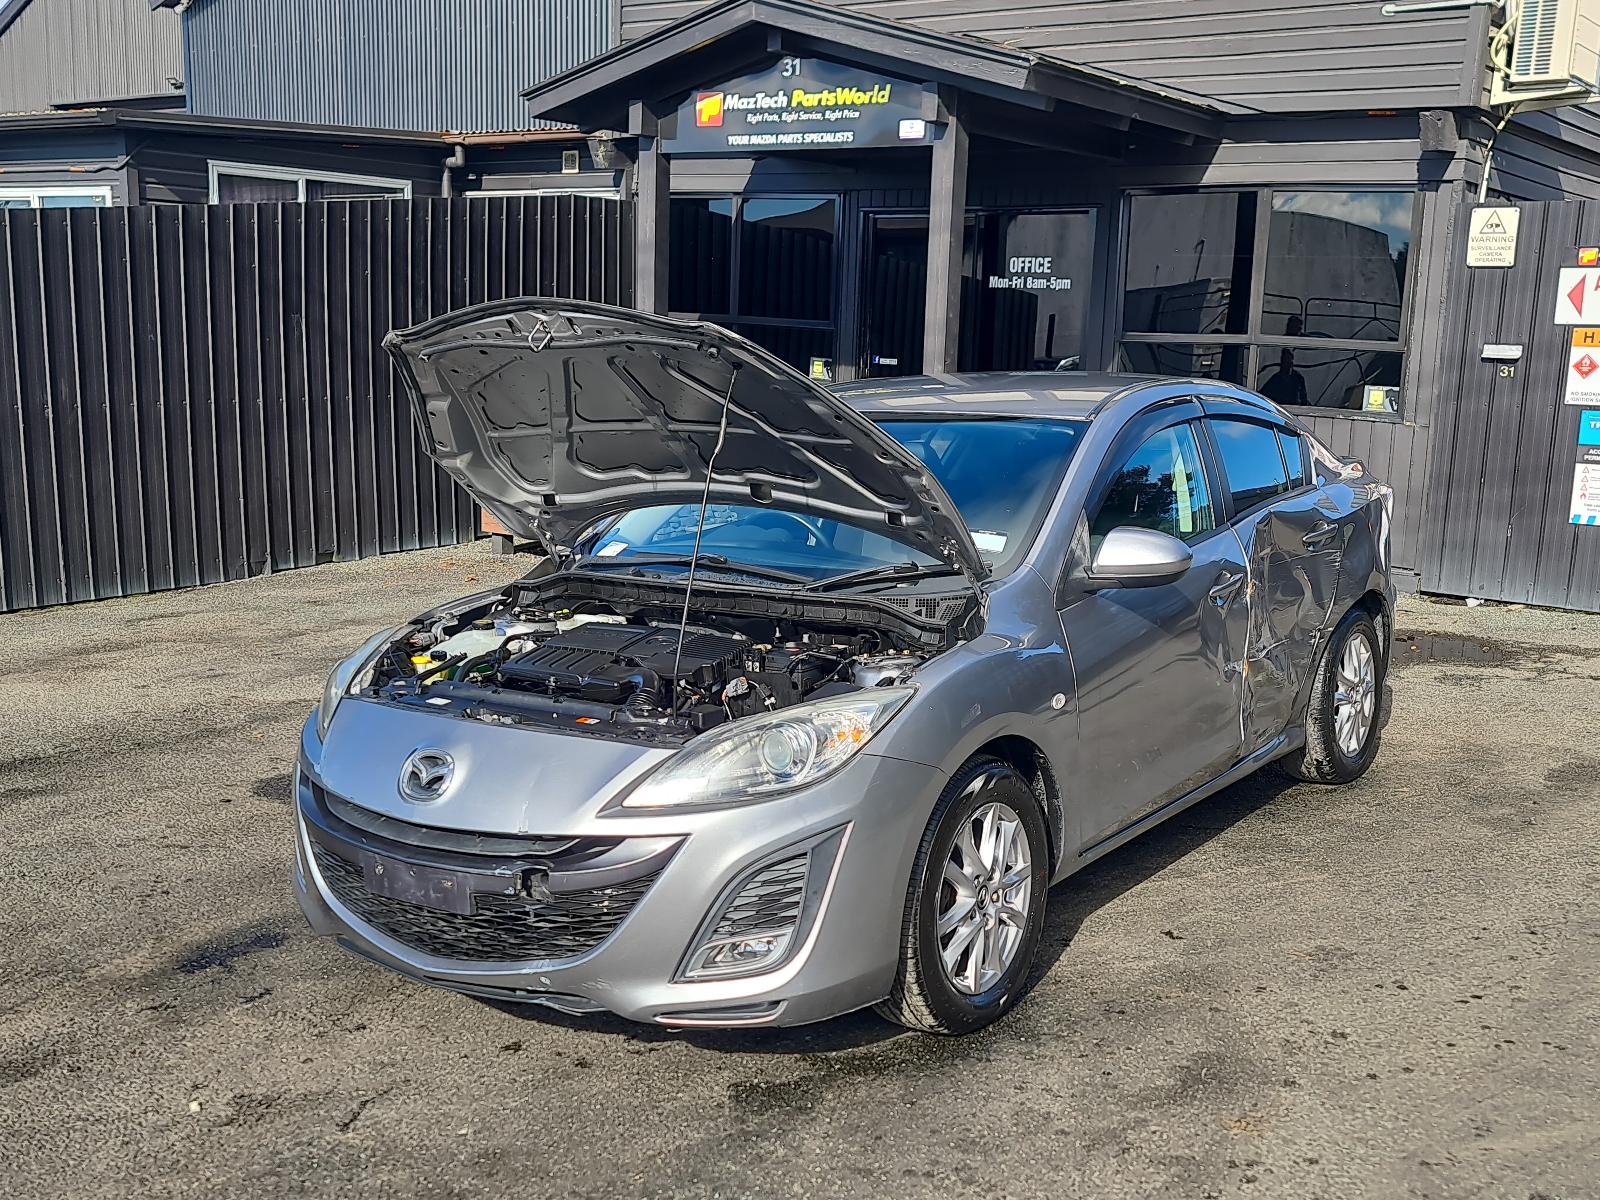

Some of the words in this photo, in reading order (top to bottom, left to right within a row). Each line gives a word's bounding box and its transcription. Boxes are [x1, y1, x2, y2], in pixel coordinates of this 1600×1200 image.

[782, 58, 800, 77] 31
[724, 90, 788, 110] MazTech
[791, 84, 892, 107] PartsWorld
[747, 113, 763, 124] Right
[781, 111, 798, 123] Right
[825, 110, 842, 121] Right
[842, 109, 860, 119] Price
[727, 134, 750, 145] YOUR
[750, 134, 777, 144] MAZDA
[777, 133, 803, 144] PARTS
[803, 131, 854, 143] SPECIALISTS
[1471, 235, 1514, 243] WARNING
[1009, 257, 1052, 273] OFFICE
[989, 275, 1025, 289] Mon-Fri
[1026, 276, 1071, 290] 8am-5pm
[1583, 331, 1600, 344] H
[1499, 366, 1515, 378] 31
